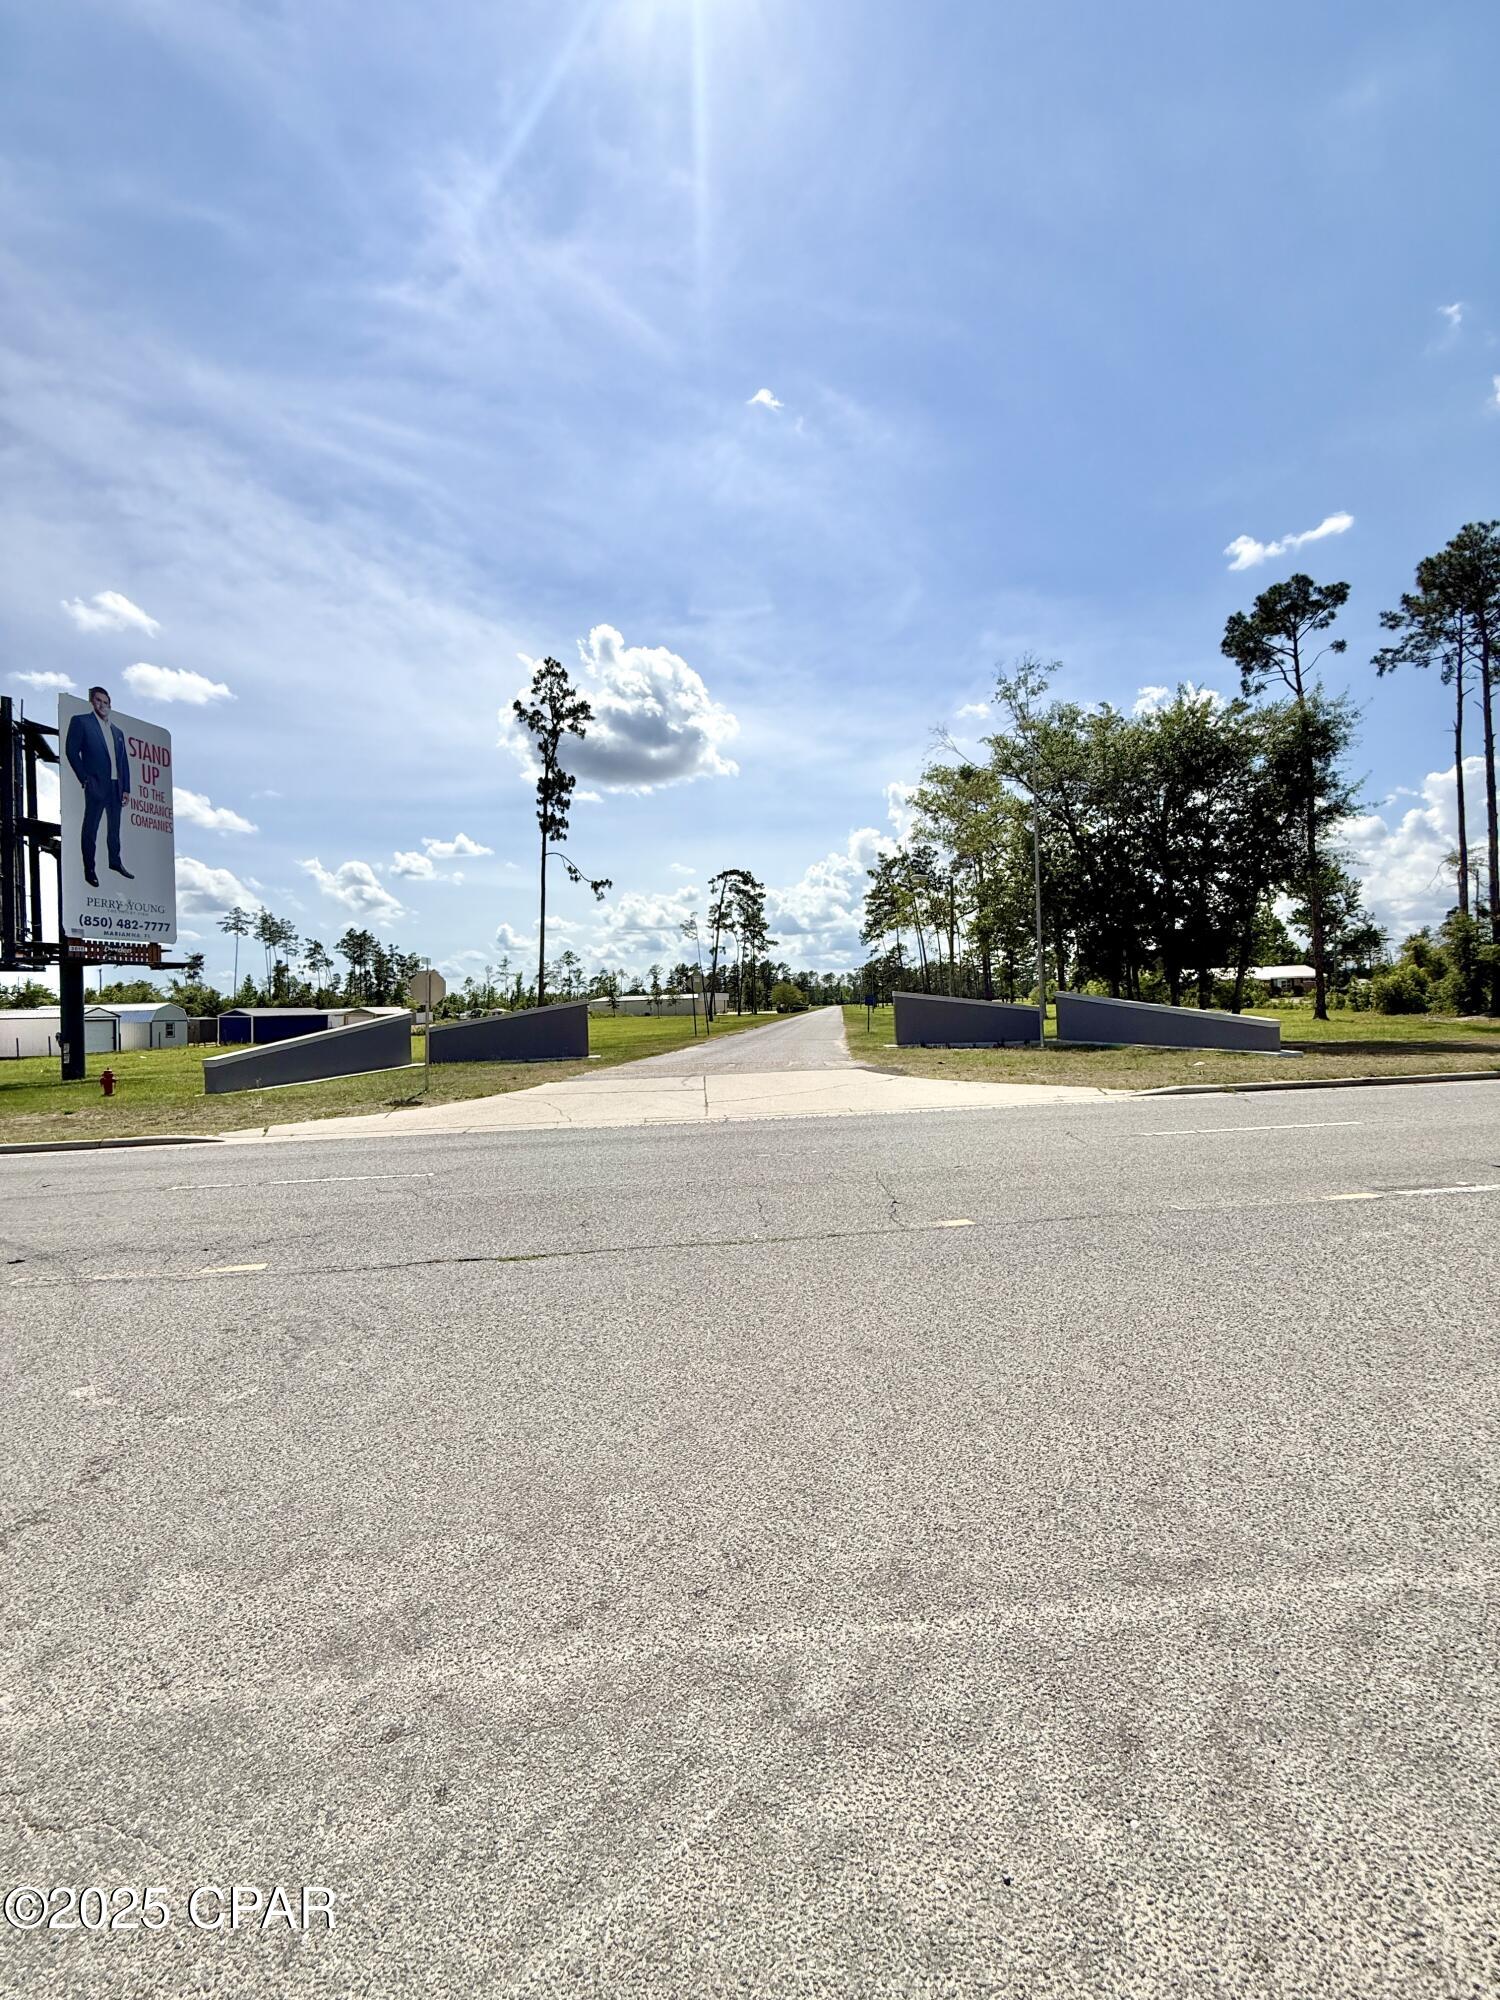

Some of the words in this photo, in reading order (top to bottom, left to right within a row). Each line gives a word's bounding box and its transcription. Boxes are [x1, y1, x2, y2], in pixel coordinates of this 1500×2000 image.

[128, 736, 171, 768] STAND
[142, 763, 160, 786] UP
[138, 785, 149, 799] TO
[151, 788, 165, 803] THE
[130, 797, 173, 820] INSURANCE
[130, 812, 173, 834] COMPANIES
[86, 896, 121, 910] PERRY
[127, 900, 166, 914] YOUNG
[79, 913, 113, 929] (850)
[116, 918, 171, 932] 482-7777
[103, 930, 141, 938] MARIANNA
